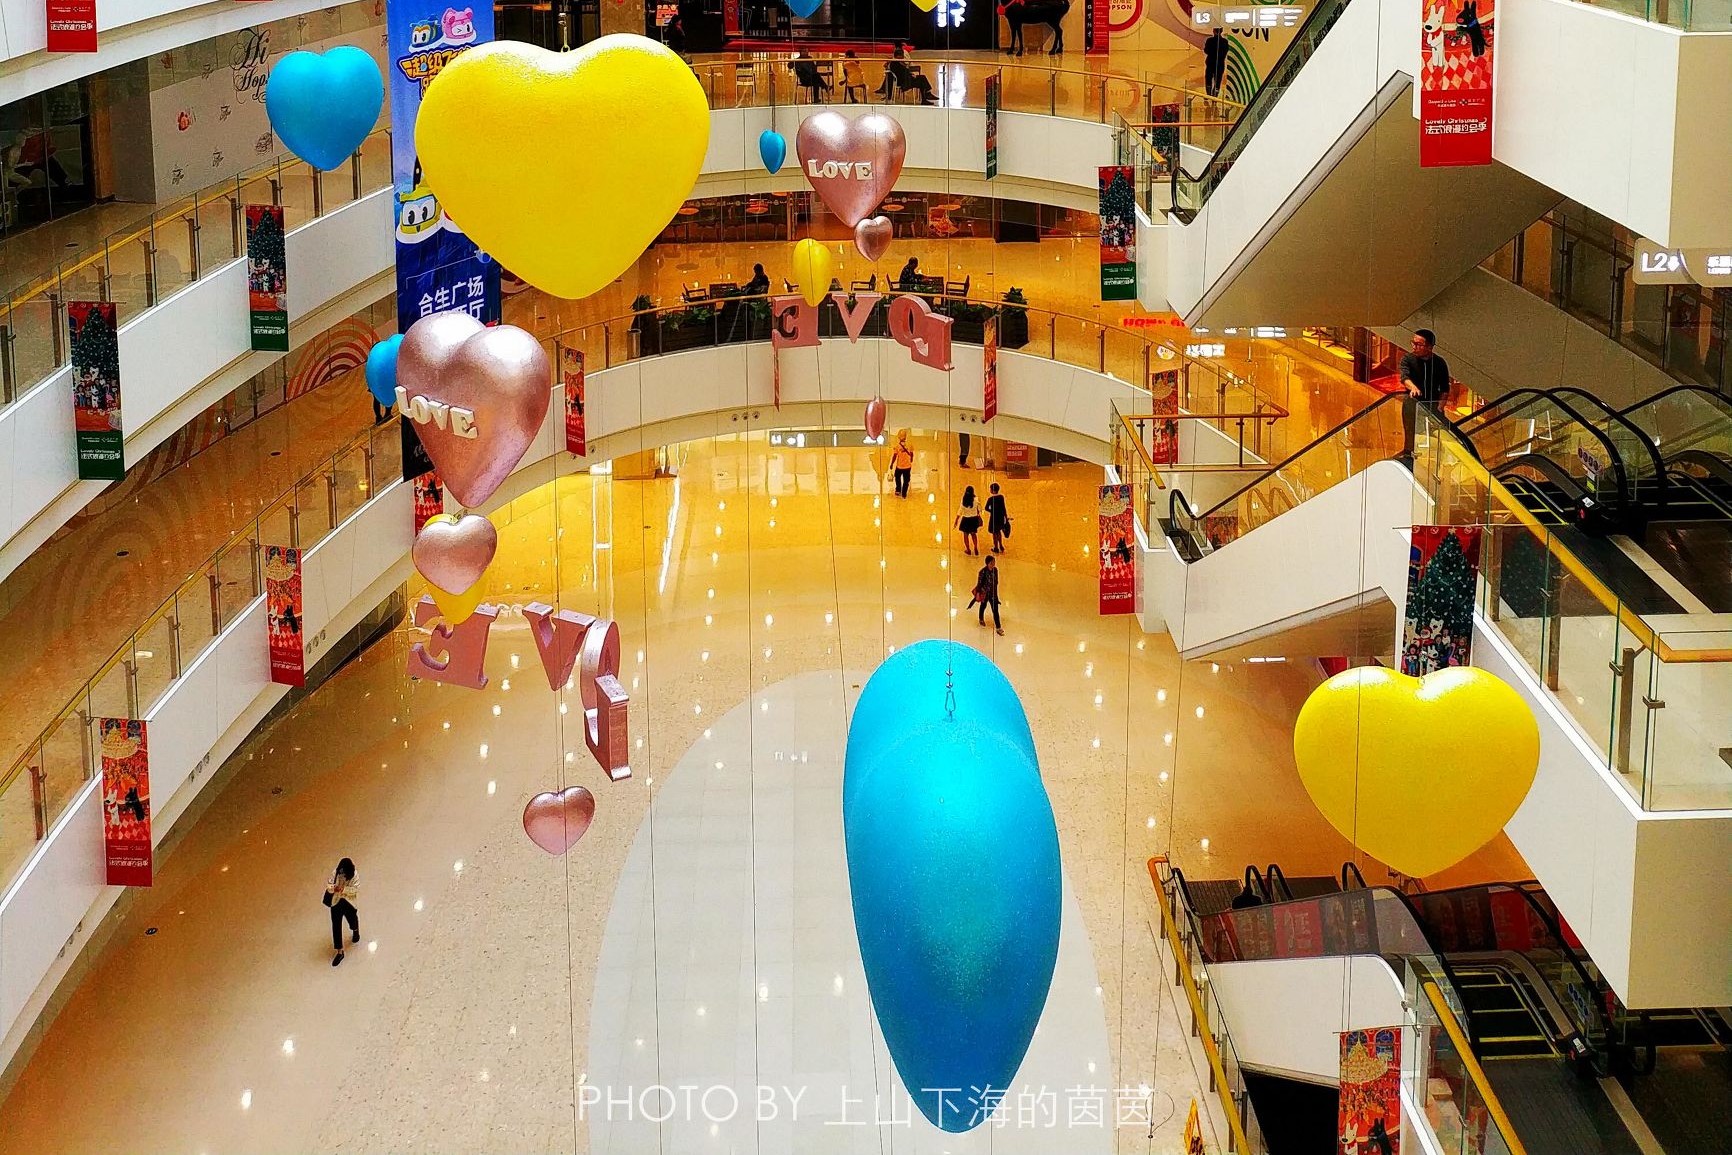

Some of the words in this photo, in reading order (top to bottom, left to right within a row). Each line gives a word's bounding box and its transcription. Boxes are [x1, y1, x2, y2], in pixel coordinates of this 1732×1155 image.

[807, 158, 874, 181] LOVE
[1641, 252, 1668, 272] L2
[418, 275, 485, 318] 合生广场
[394, 385, 479, 439] LOVE
